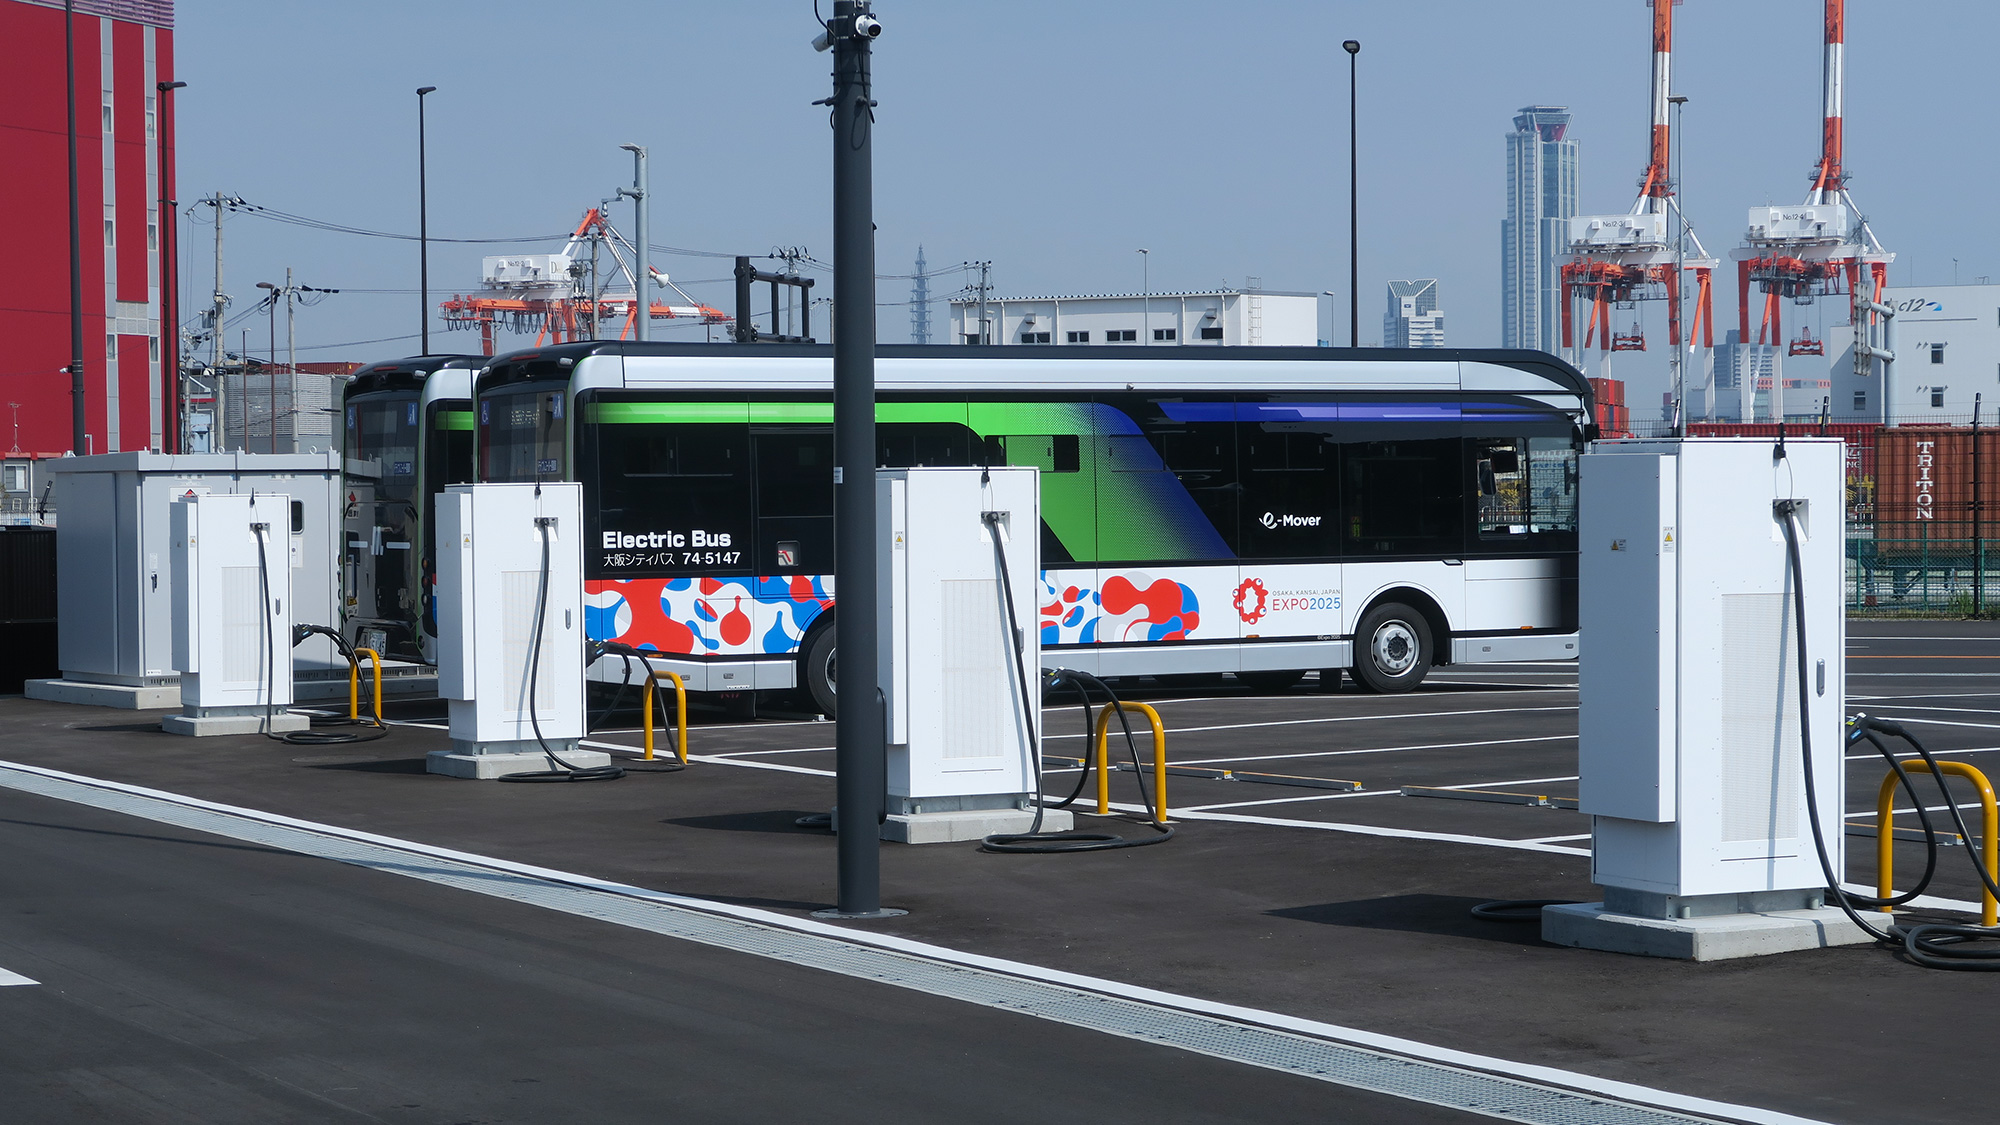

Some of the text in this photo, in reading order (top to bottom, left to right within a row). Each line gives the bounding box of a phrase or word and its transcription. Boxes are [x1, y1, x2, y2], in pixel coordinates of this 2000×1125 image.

[1915, 441, 1934, 519] TRITON
[1258, 511, 1321, 530] e-Mover
[602, 530, 732, 549] Electric Bus
[603, 551, 741, 567] 大阪シティバス 74-5147
[1272, 597, 1341, 611] EXPO2025
